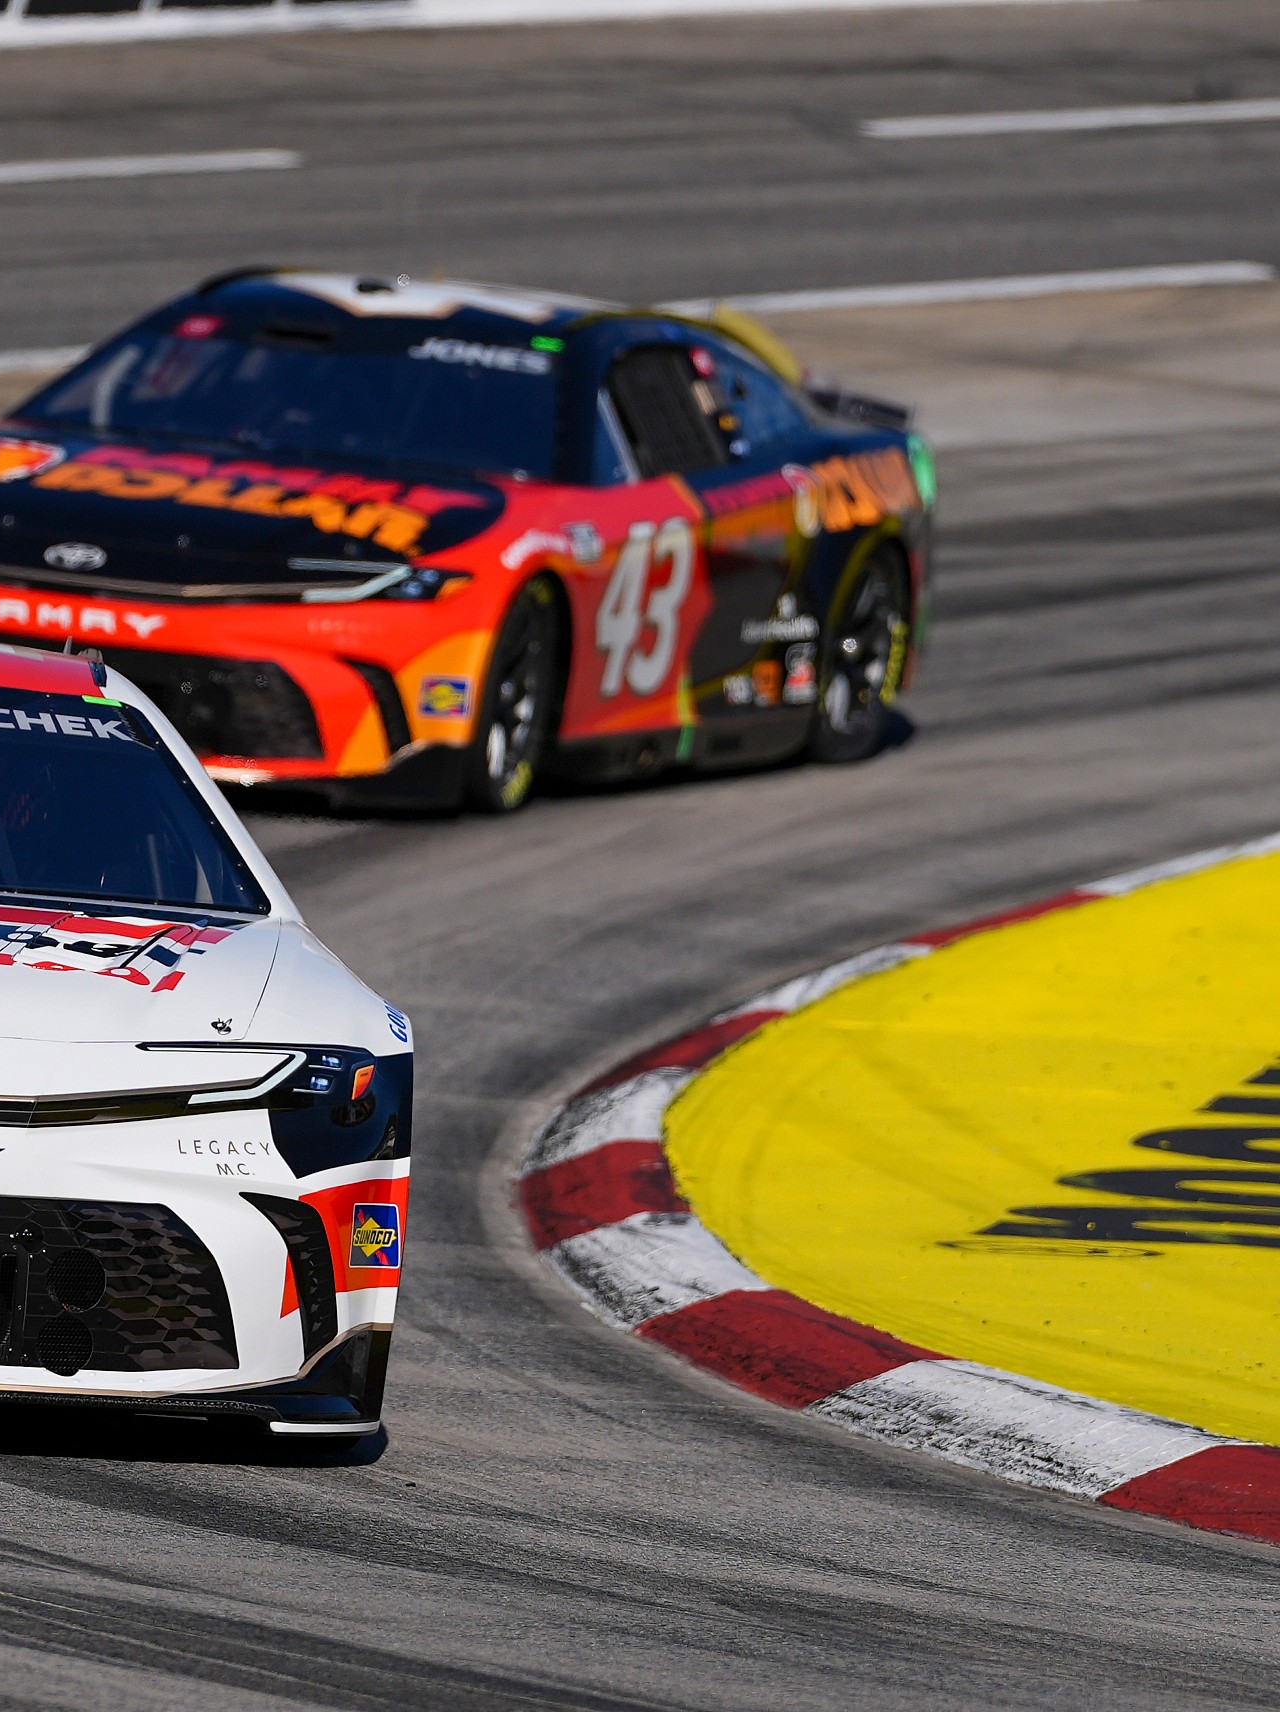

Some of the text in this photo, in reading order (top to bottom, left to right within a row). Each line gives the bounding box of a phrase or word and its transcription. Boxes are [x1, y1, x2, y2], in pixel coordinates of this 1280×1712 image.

[595, 517, 696, 697] 43
[177, 1139, 271, 1156] LEGACY
[216, 1162, 256, 1176] M.C.
[353, 1228, 394, 1245] SUNOCO
